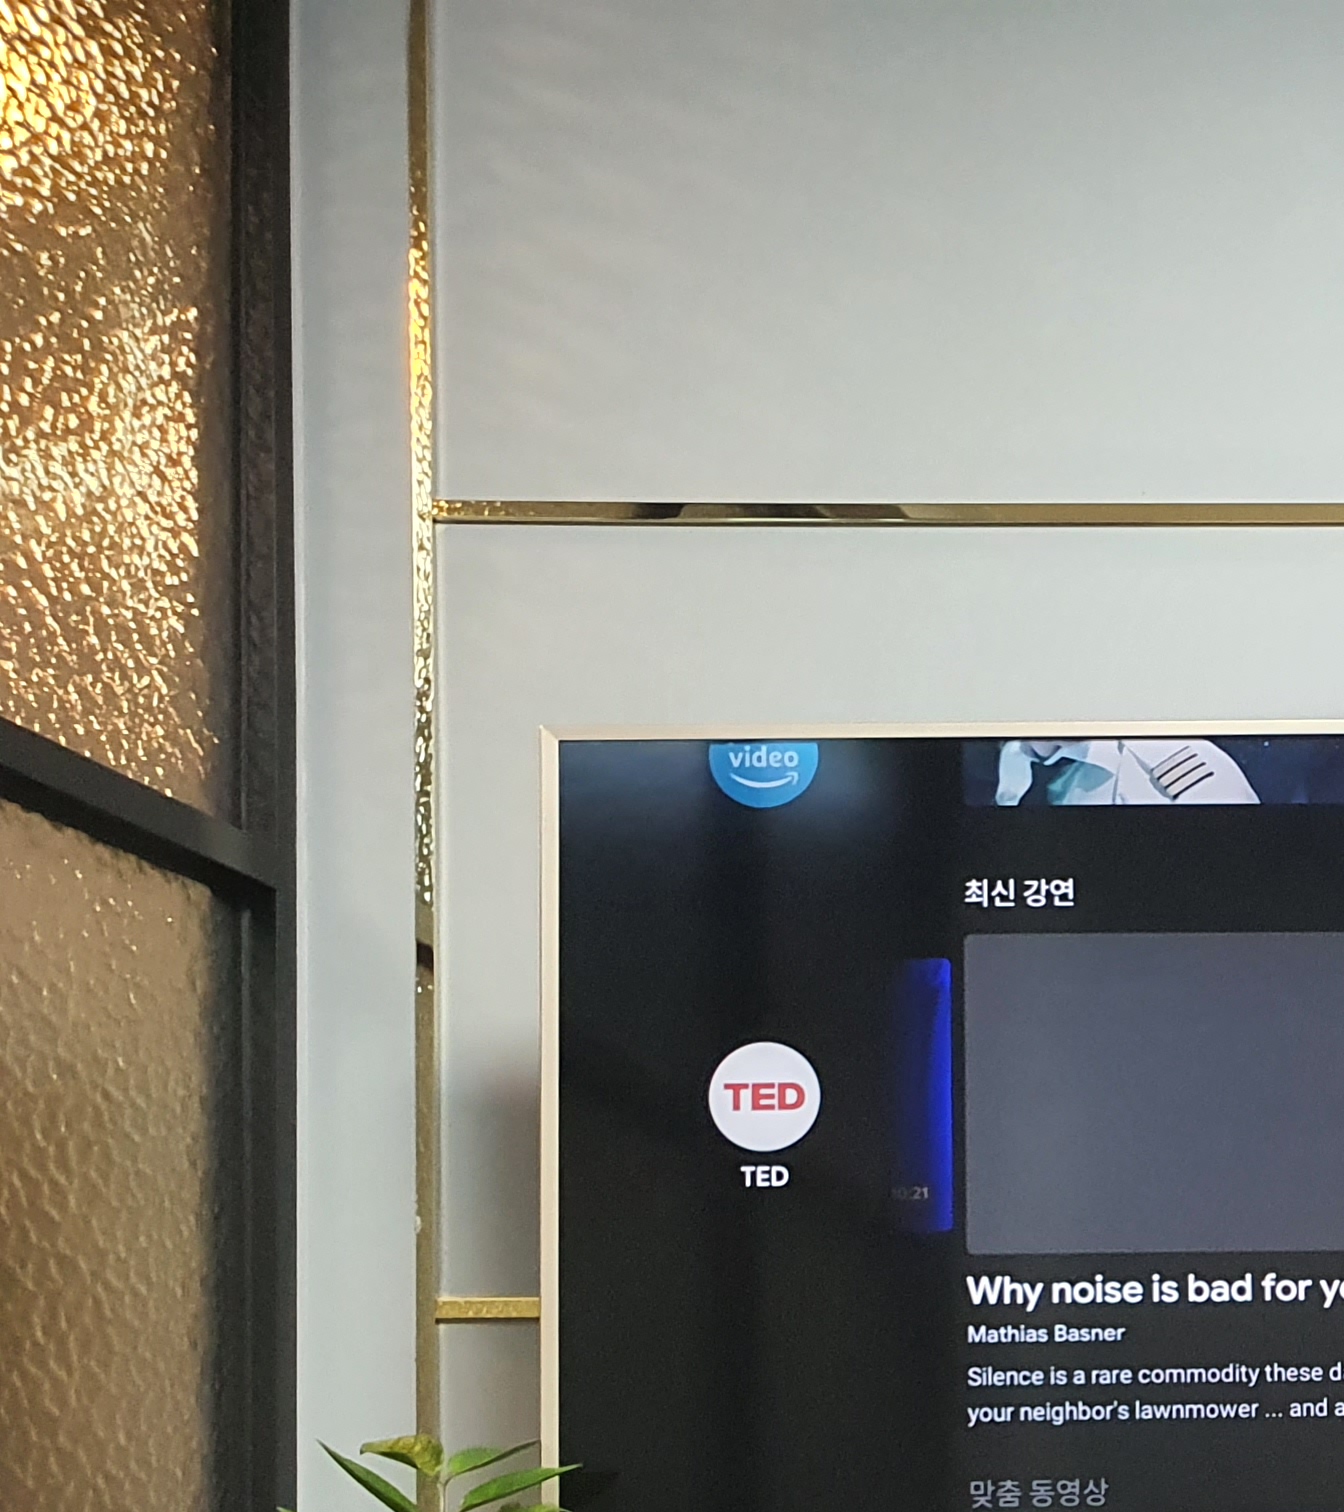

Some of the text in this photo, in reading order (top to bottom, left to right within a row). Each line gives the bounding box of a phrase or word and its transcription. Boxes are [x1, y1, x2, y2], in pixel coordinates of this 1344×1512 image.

[728, 746, 799, 769] video
[964, 877, 1075, 908] 최신 강연
[723, 1083, 806, 1111] TED
[740, 1165, 790, 1188] TED
[965, 1275, 1045, 1313] Why
[1051, 1273, 1144, 1304] noise
[1151, 1273, 1180, 1303] is
[1187, 1272, 1253, 1303] bad
[1260, 1272, 1313, 1302] for
[967, 1323, 1126, 1344] Mathias Basner
[967, 1366, 1045, 1387] Silence
[1049, 1366, 1068, 1385] is
[1072, 1369, 1086, 1385] a
[1091, 1369, 1133, 1385] rare
[1137, 1362, 1260, 1388] commodity
[1264, 1362, 1324, 1383] these
[967, 1406, 1015, 1428] your
[1019, 1400, 1130, 1426] neighbor's
[1135, 1399, 1260, 1420] lawnmower
[1289, 1397, 1328, 1418] and
[969, 1477, 1109, 1509] 맞춤 동영상
